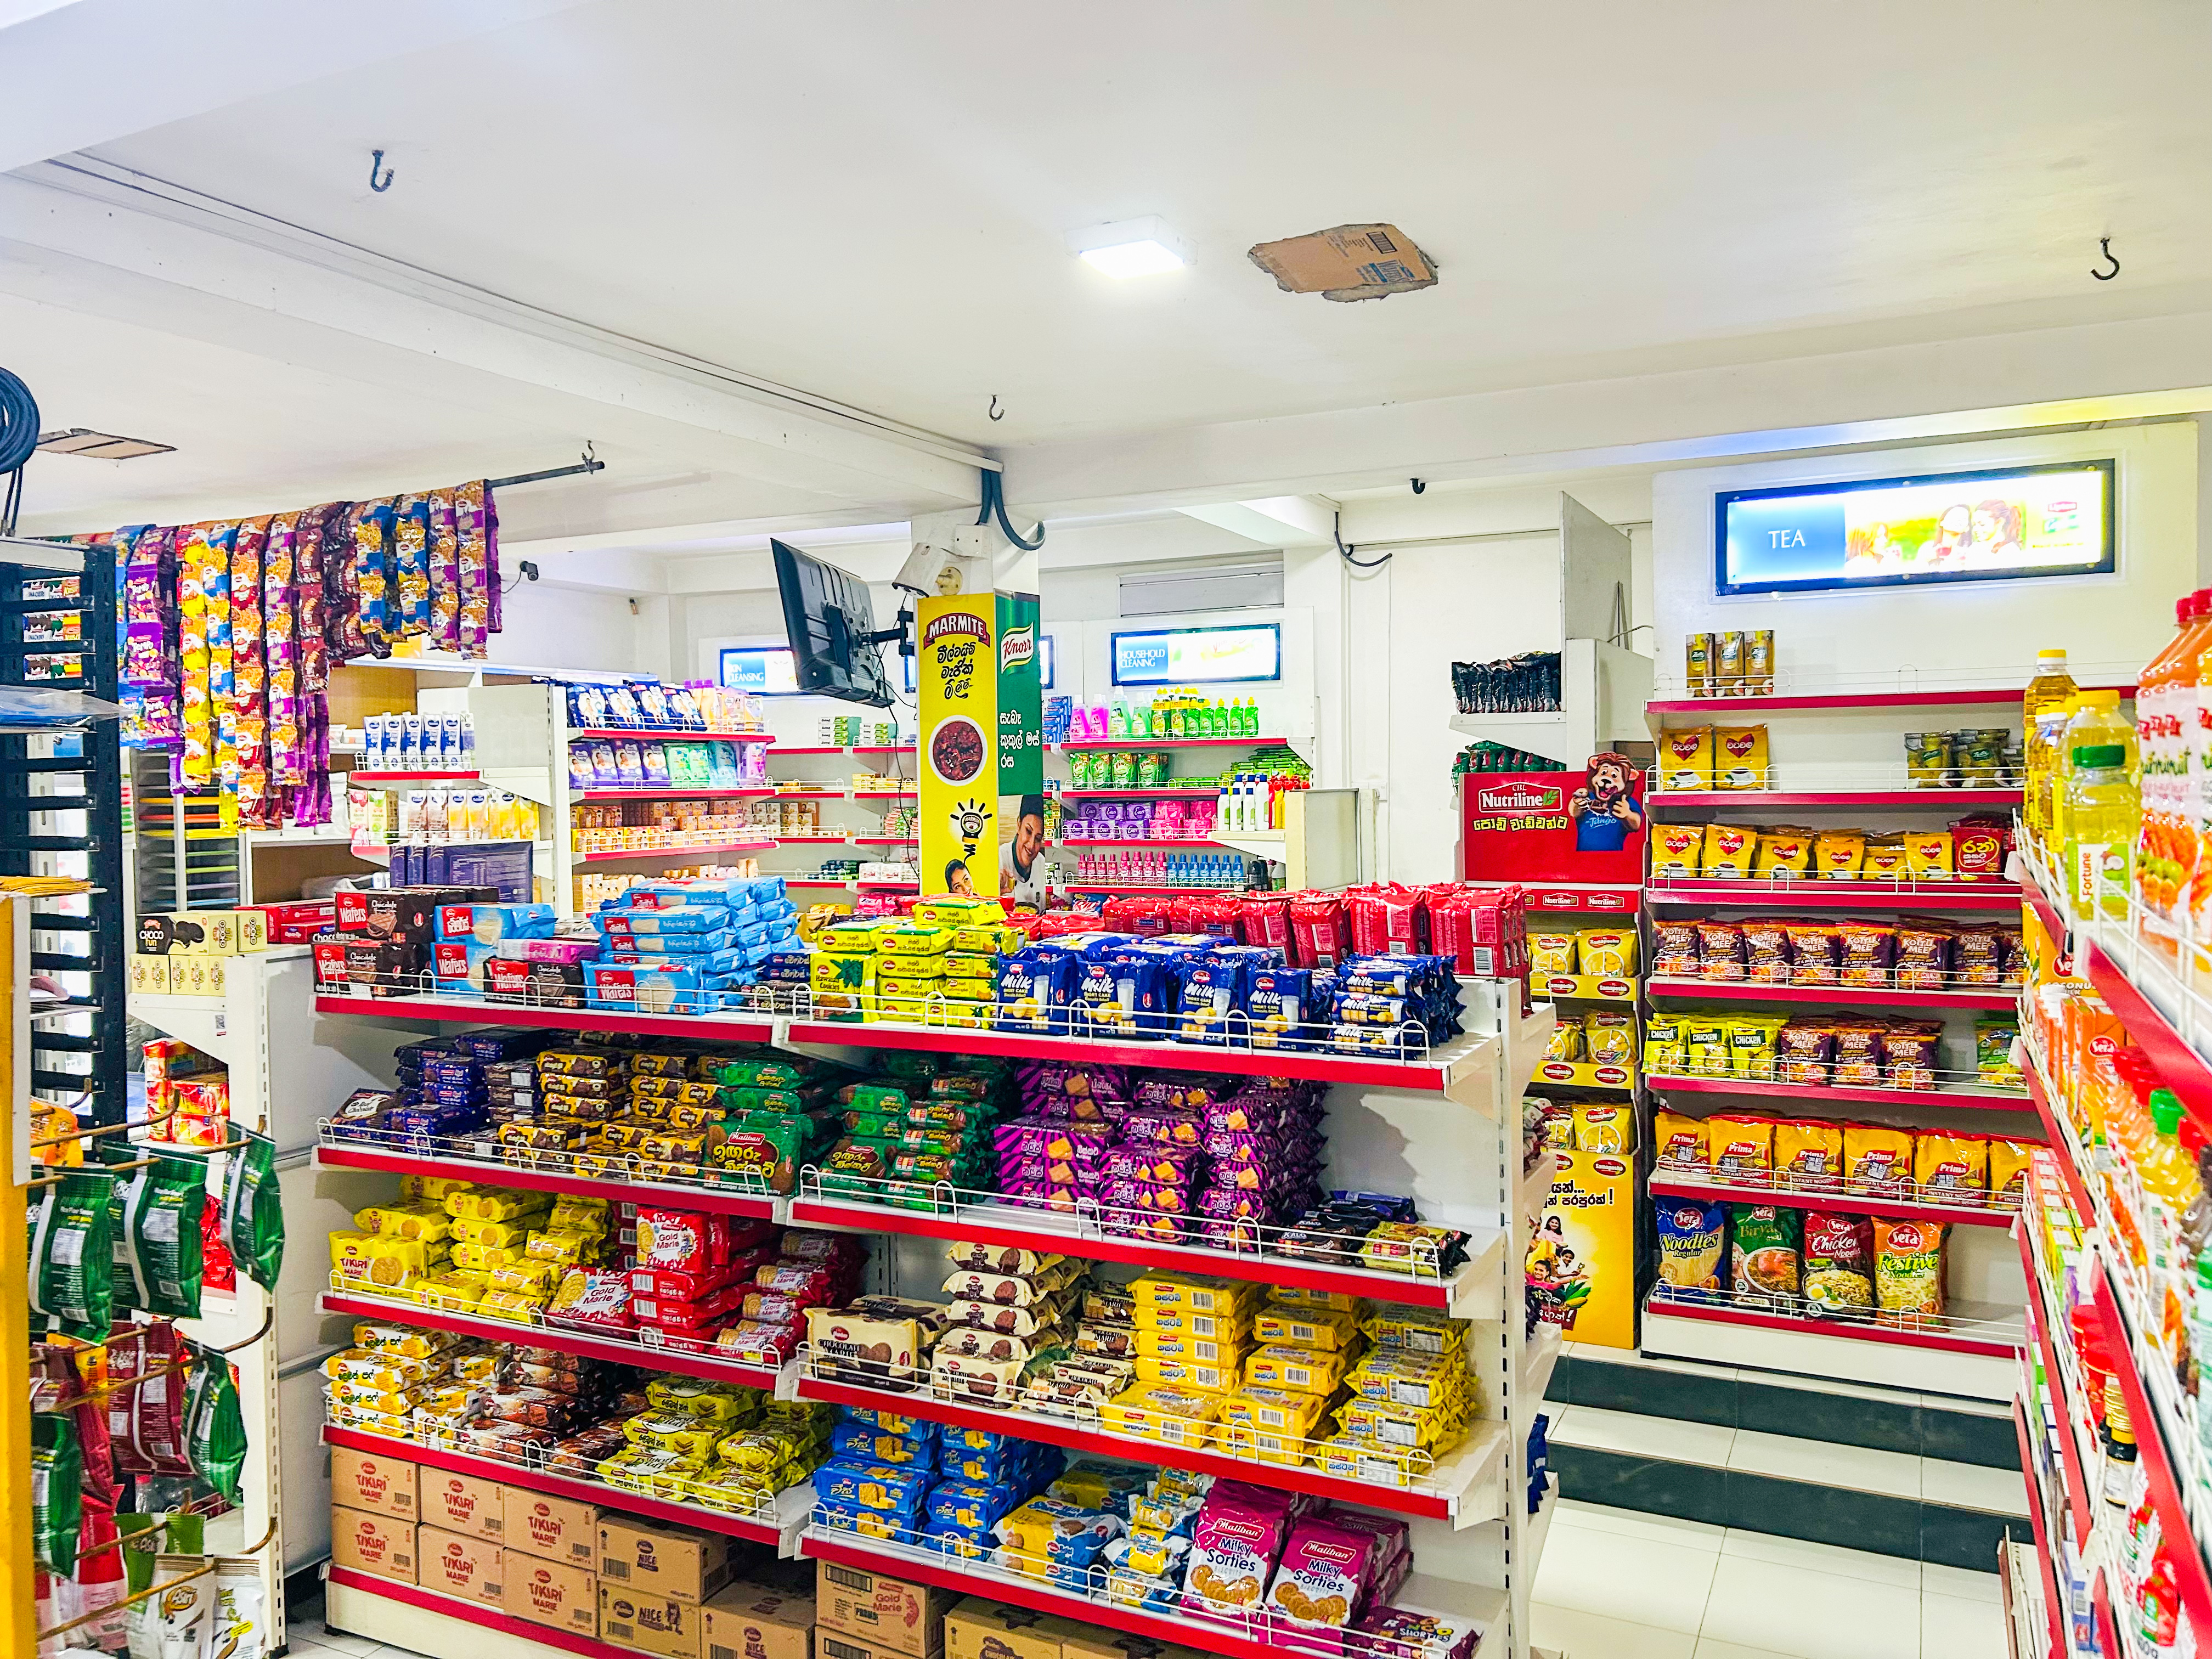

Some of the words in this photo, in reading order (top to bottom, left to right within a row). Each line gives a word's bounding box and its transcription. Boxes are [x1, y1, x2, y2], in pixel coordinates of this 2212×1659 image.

[1768, 529, 1805, 550] TEA
[929, 615, 984, 639] MARMITE
[1002, 638, 1032, 659] Knorr
[1120, 649, 1166, 658] HOUSEHOLD
[1120, 658, 1155, 668] CLEANING
[1001, 752, 1015, 768] රස
[1481, 792, 1544, 808] Nutriline
[2082, 852, 2092, 896] Fortune
[340, 907, 366, 923] Wafers
[139, 930, 163, 940] CHOCO
[1667, 934, 1686, 942] MEE
[1706, 932, 1733, 941] KOTTU
[1753, 931, 1779, 941] KOTTU
[1797, 935, 1826, 945] KOTTU
[1846, 934, 1877, 945] KOTTU
[1960, 933, 1991, 944] KOTTU
[1710, 939, 1731, 949] MEE
[1758, 939, 1778, 949] MEE
[1802, 943, 1823, 951] MEE
[1851, 942, 1872, 952] MEE
[1902, 937, 1933, 948] KOTTU
[1965, 940, 1988, 951] MEE
[1908, 945, 1930, 955] MEE
[438, 958, 466, 974] Wafers
[1001, 973, 1033, 989] Milk
[1081, 975, 1115, 993] Milk
[1346, 975, 1374, 987] Milk
[1184, 982, 1215, 998] Milk
[1250, 990, 1282, 1005] Milk
[1341, 998, 1370, 1011] Milk
[1334, 1028, 1363, 1037] Milk
[1651, 1030, 1674, 1040] CHICKEN
[1692, 1033, 1718, 1042] CHICKEN
[1788, 1031, 1819, 1041] KOTTU
[1839, 1033, 1870, 1043] KOTTU
[1735, 1035, 1762, 1045] CHICKEN
[1793, 1039, 1814, 1049] MEE
[1845, 1040, 1866, 1050] MEE
[1887, 1041, 1919, 1052] KOTTU
[1894, 1048, 1916, 1058] MEE
[731, 1133, 763, 1142] Maliban
[1673, 1134, 1695, 1143] Prima
[1729, 1144, 1752, 1154] Prima
[1867, 1152, 1892, 1161] Prima
[1939, 1164, 1966, 1173] Prima
[657, 1241, 679, 1249] Marie
[1660, 1233, 1718, 1251] Noodles
[1811, 1234, 1857, 1252] Chicken
[340, 1257, 368, 1268] TIKIRI
[1876, 1251, 1939, 1272] Festive
[591, 1286, 616, 1296] Gold
[583, 1295, 613, 1304] Marie
[356, 1474, 386, 1490] TIKIRI
[360, 1488, 382, 1499] MARIE
[442, 1493, 475, 1510] TIKIRI
[448, 1507, 471, 1519] MARIE
[528, 1516, 561, 1536] TIKIRI
[1217, 1520, 1262, 1539] Maliban
[355, 1535, 386, 1551] TIKIRI
[532, 1531, 556, 1544] MARIE
[1220, 1537, 1252, 1556] Milky
[1307, 1542, 1353, 1560] Maliban
[359, 1548, 382, 1560] MARIE
[441, 1556, 473, 1574] TIKIRI
[637, 1554, 657, 1566] NICE
[1206, 1549, 1256, 1572] Sorties
[1308, 1559, 1341, 1578] Milky
[446, 1571, 470, 1583] MARIE
[1293, 1569, 1345, 1592] Sorties
[528, 1582, 562, 1602] TIKIRI
[874, 1593, 900, 1602] Gold
[533, 1598, 557, 1611] MARIE
[873, 1602, 902, 1612] Marie
[639, 1607, 662, 1622] NICE
